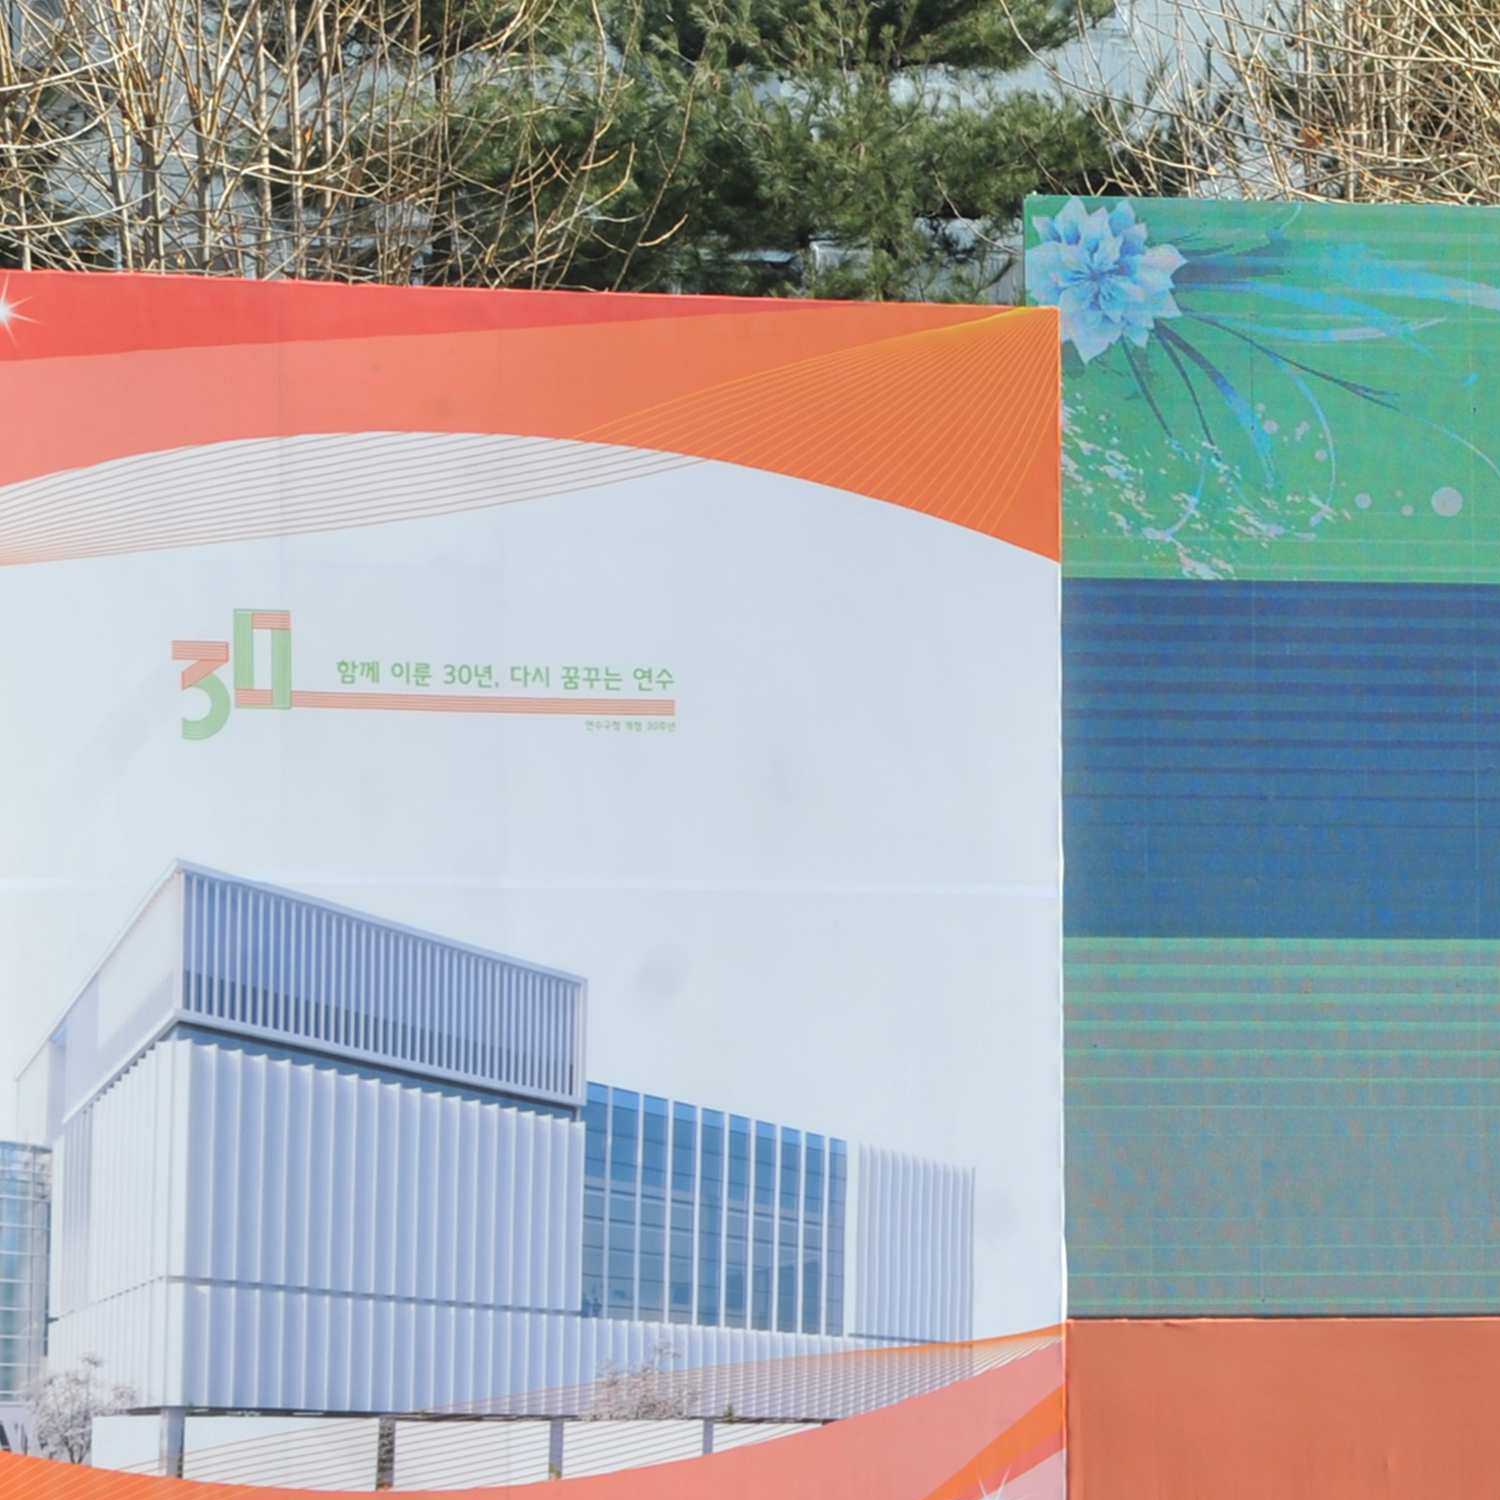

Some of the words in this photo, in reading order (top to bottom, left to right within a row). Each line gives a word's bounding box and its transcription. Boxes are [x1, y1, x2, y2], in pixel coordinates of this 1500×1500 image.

[336, 659, 380, 685] 함께
[391, 661, 432, 687] 이룬
[443, 664, 499, 689] 30년,
[510, 666, 551, 688] 다시
[561, 666, 623, 691] 꿈꾸는
[633, 667, 675, 691] 연수
